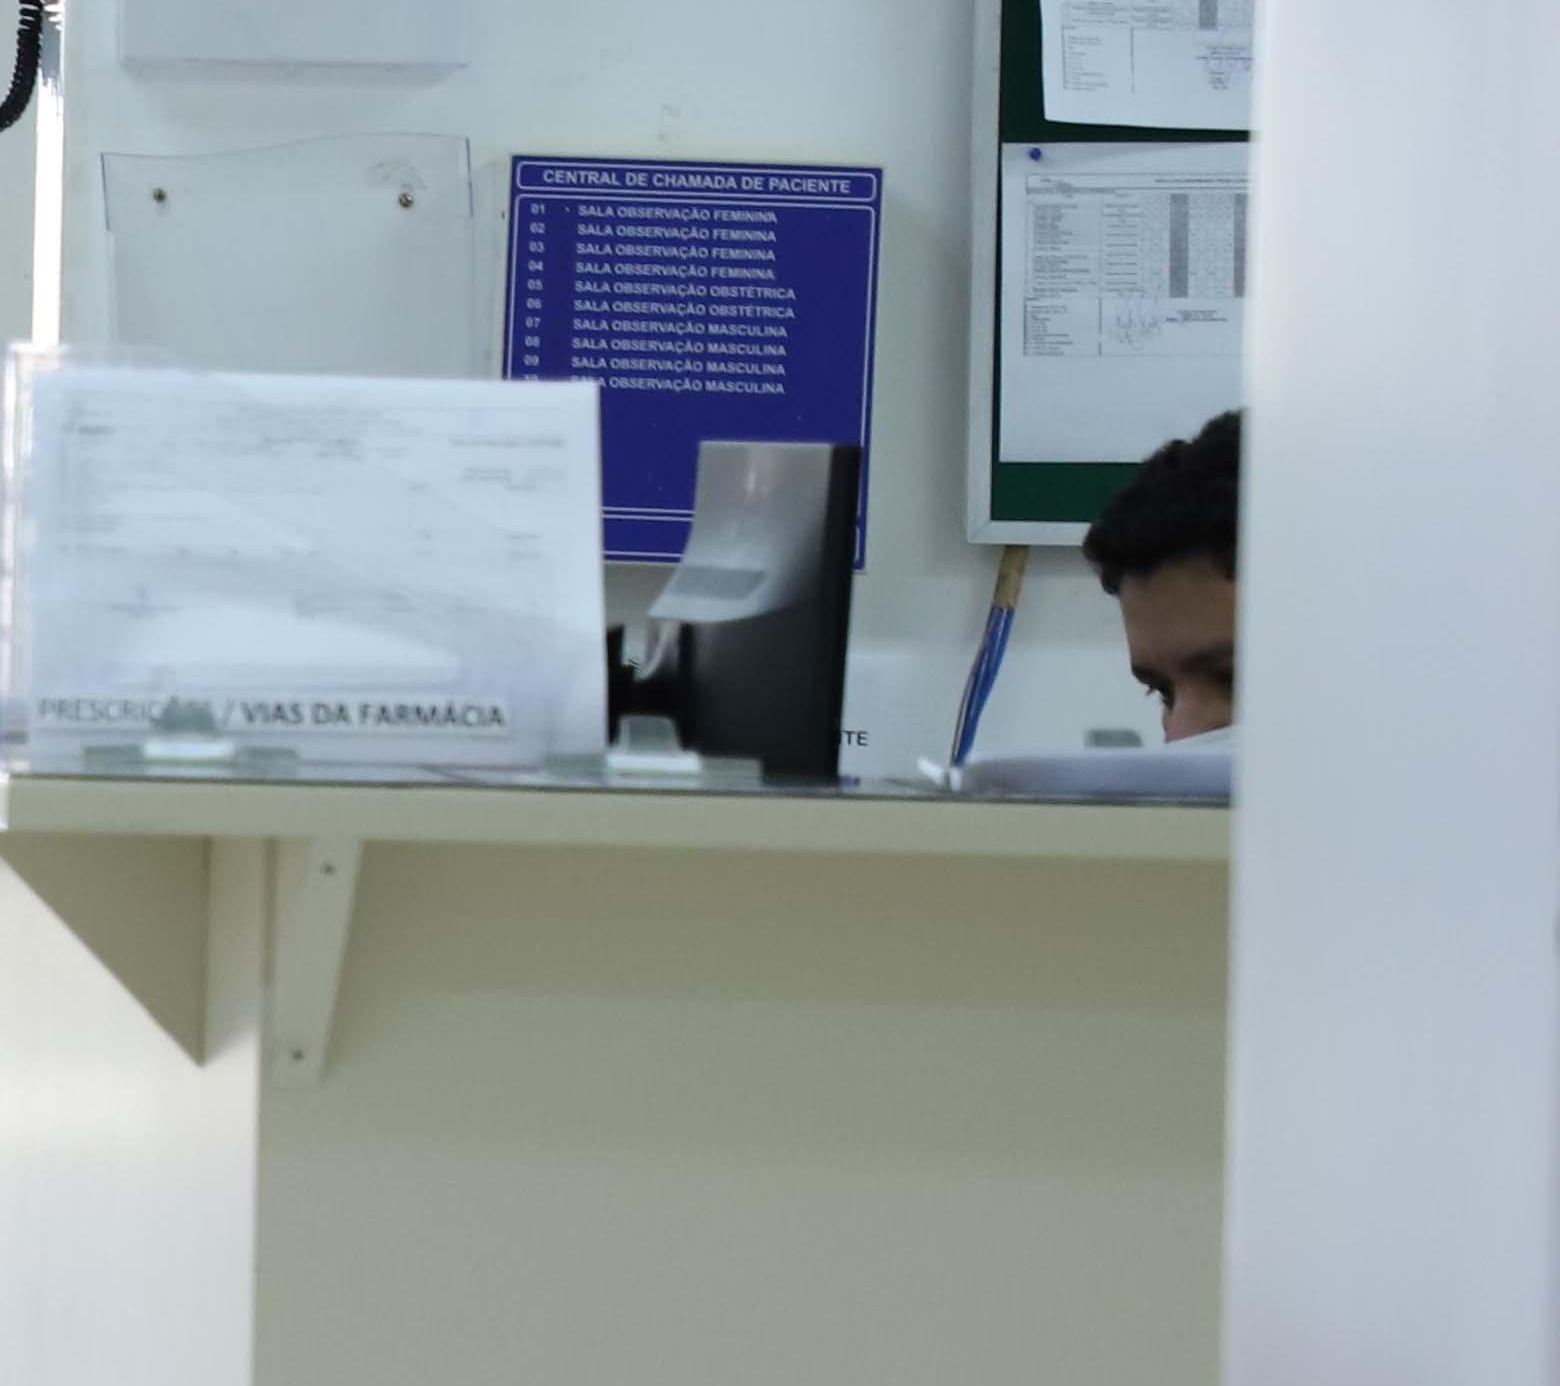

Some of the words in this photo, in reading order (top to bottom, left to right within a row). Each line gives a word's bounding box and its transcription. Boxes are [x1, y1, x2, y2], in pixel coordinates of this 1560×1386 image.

[542, 169, 622, 186] CENTRAL
[625, 171, 649, 187] DE
[652, 173, 738, 190] CHAMADA
[741, 176, 765, 191] DE
[768, 176, 852, 194] PACIENTE
[530, 203, 546, 214] 01
[578, 204, 614, 217] SALA
[617, 206, 711, 221] OBSERVAÇÃO
[713, 209, 778, 223] FEMININA
[529, 222, 546, 234] 02
[577, 223, 614, 236] SALA
[616, 225, 710, 240] OBSERVAÇÃO
[712, 228, 777, 242] FEMININA
[528, 241, 545, 253] 03
[575, 242, 613, 255] SALA
[615, 243, 709, 259] OBSERVAÇÃO
[711, 247, 776, 261] FEMININA
[527, 260, 544, 272] 04
[575, 261, 612, 274] SALA
[614, 263, 708, 278] OBSERVAÇÃO
[710, 266, 776, 280] FEMININA
[527, 279, 543, 291] 05
[574, 280, 611, 293] SALA
[613, 282, 707, 297] OBSERVAÇÃO
[526, 298, 542, 310] 06
[573, 299, 610, 312] SALA
[612, 300, 706, 316] OBSERVAÇÃO
[525, 317, 541, 329] 07
[573, 318, 609, 331] SALA
[611, 319, 705, 335] OBSERVAÇÃO
[708, 323, 788, 337] MASCULINA
[572, 337, 608, 350] SALA
[610, 339, 704, 354] OBSERVAÇÃO
[707, 342, 787, 356] MASCULINA
[571, 356, 608, 369] SALA
[609, 357, 703, 372] OBSERVAÇÃO
[706, 361, 786, 376] MASCULINA
[608, 376, 702, 392] OBSERVAÇÃO
[705, 380, 785, 395] MASCULINA
[37, 696, 213, 722] PRESCRI
[240, 700, 304, 725] VIAS
[311, 701, 351, 725] DA
[358, 698, 506, 727] FARMÁCIA
